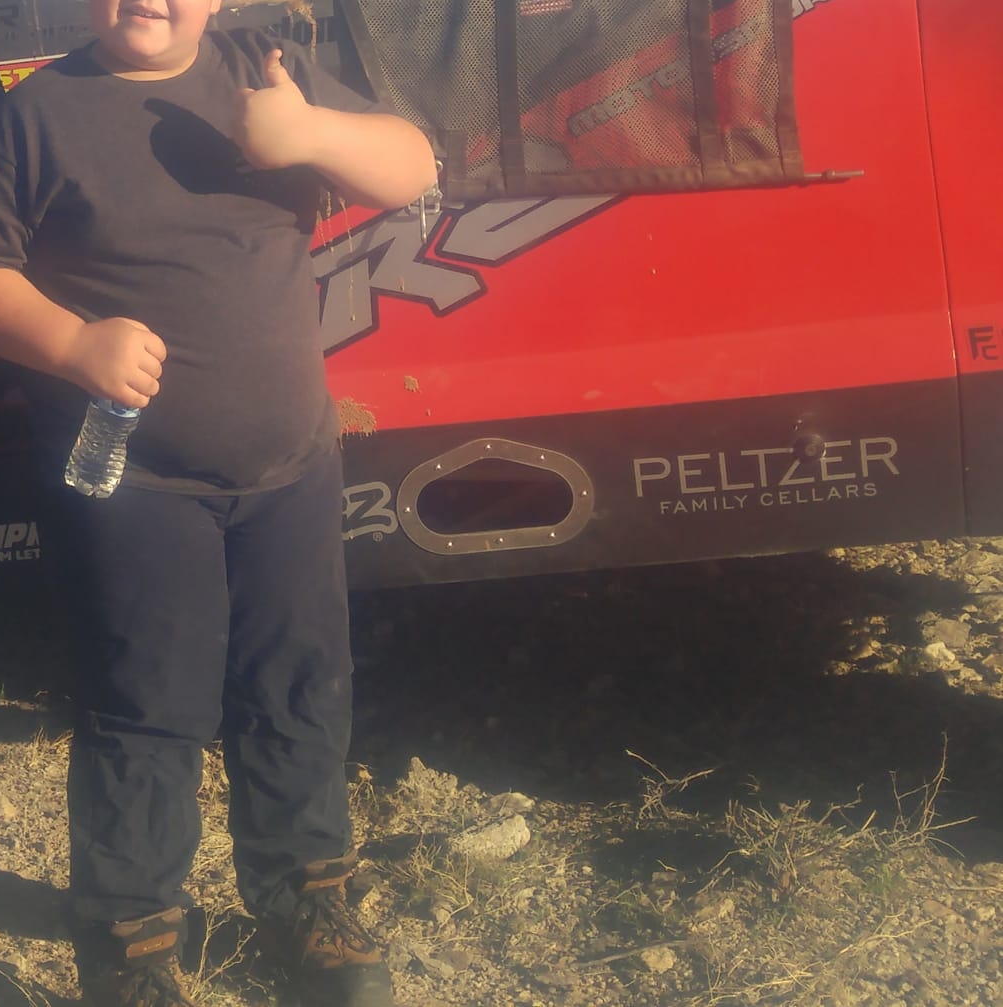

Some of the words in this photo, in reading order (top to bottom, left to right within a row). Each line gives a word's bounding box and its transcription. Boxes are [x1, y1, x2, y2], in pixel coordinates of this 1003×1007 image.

[633, 437, 900, 497] PELTZER
[660, 495, 748, 514] FAMILY
[759, 483, 877, 506] CELLARS
